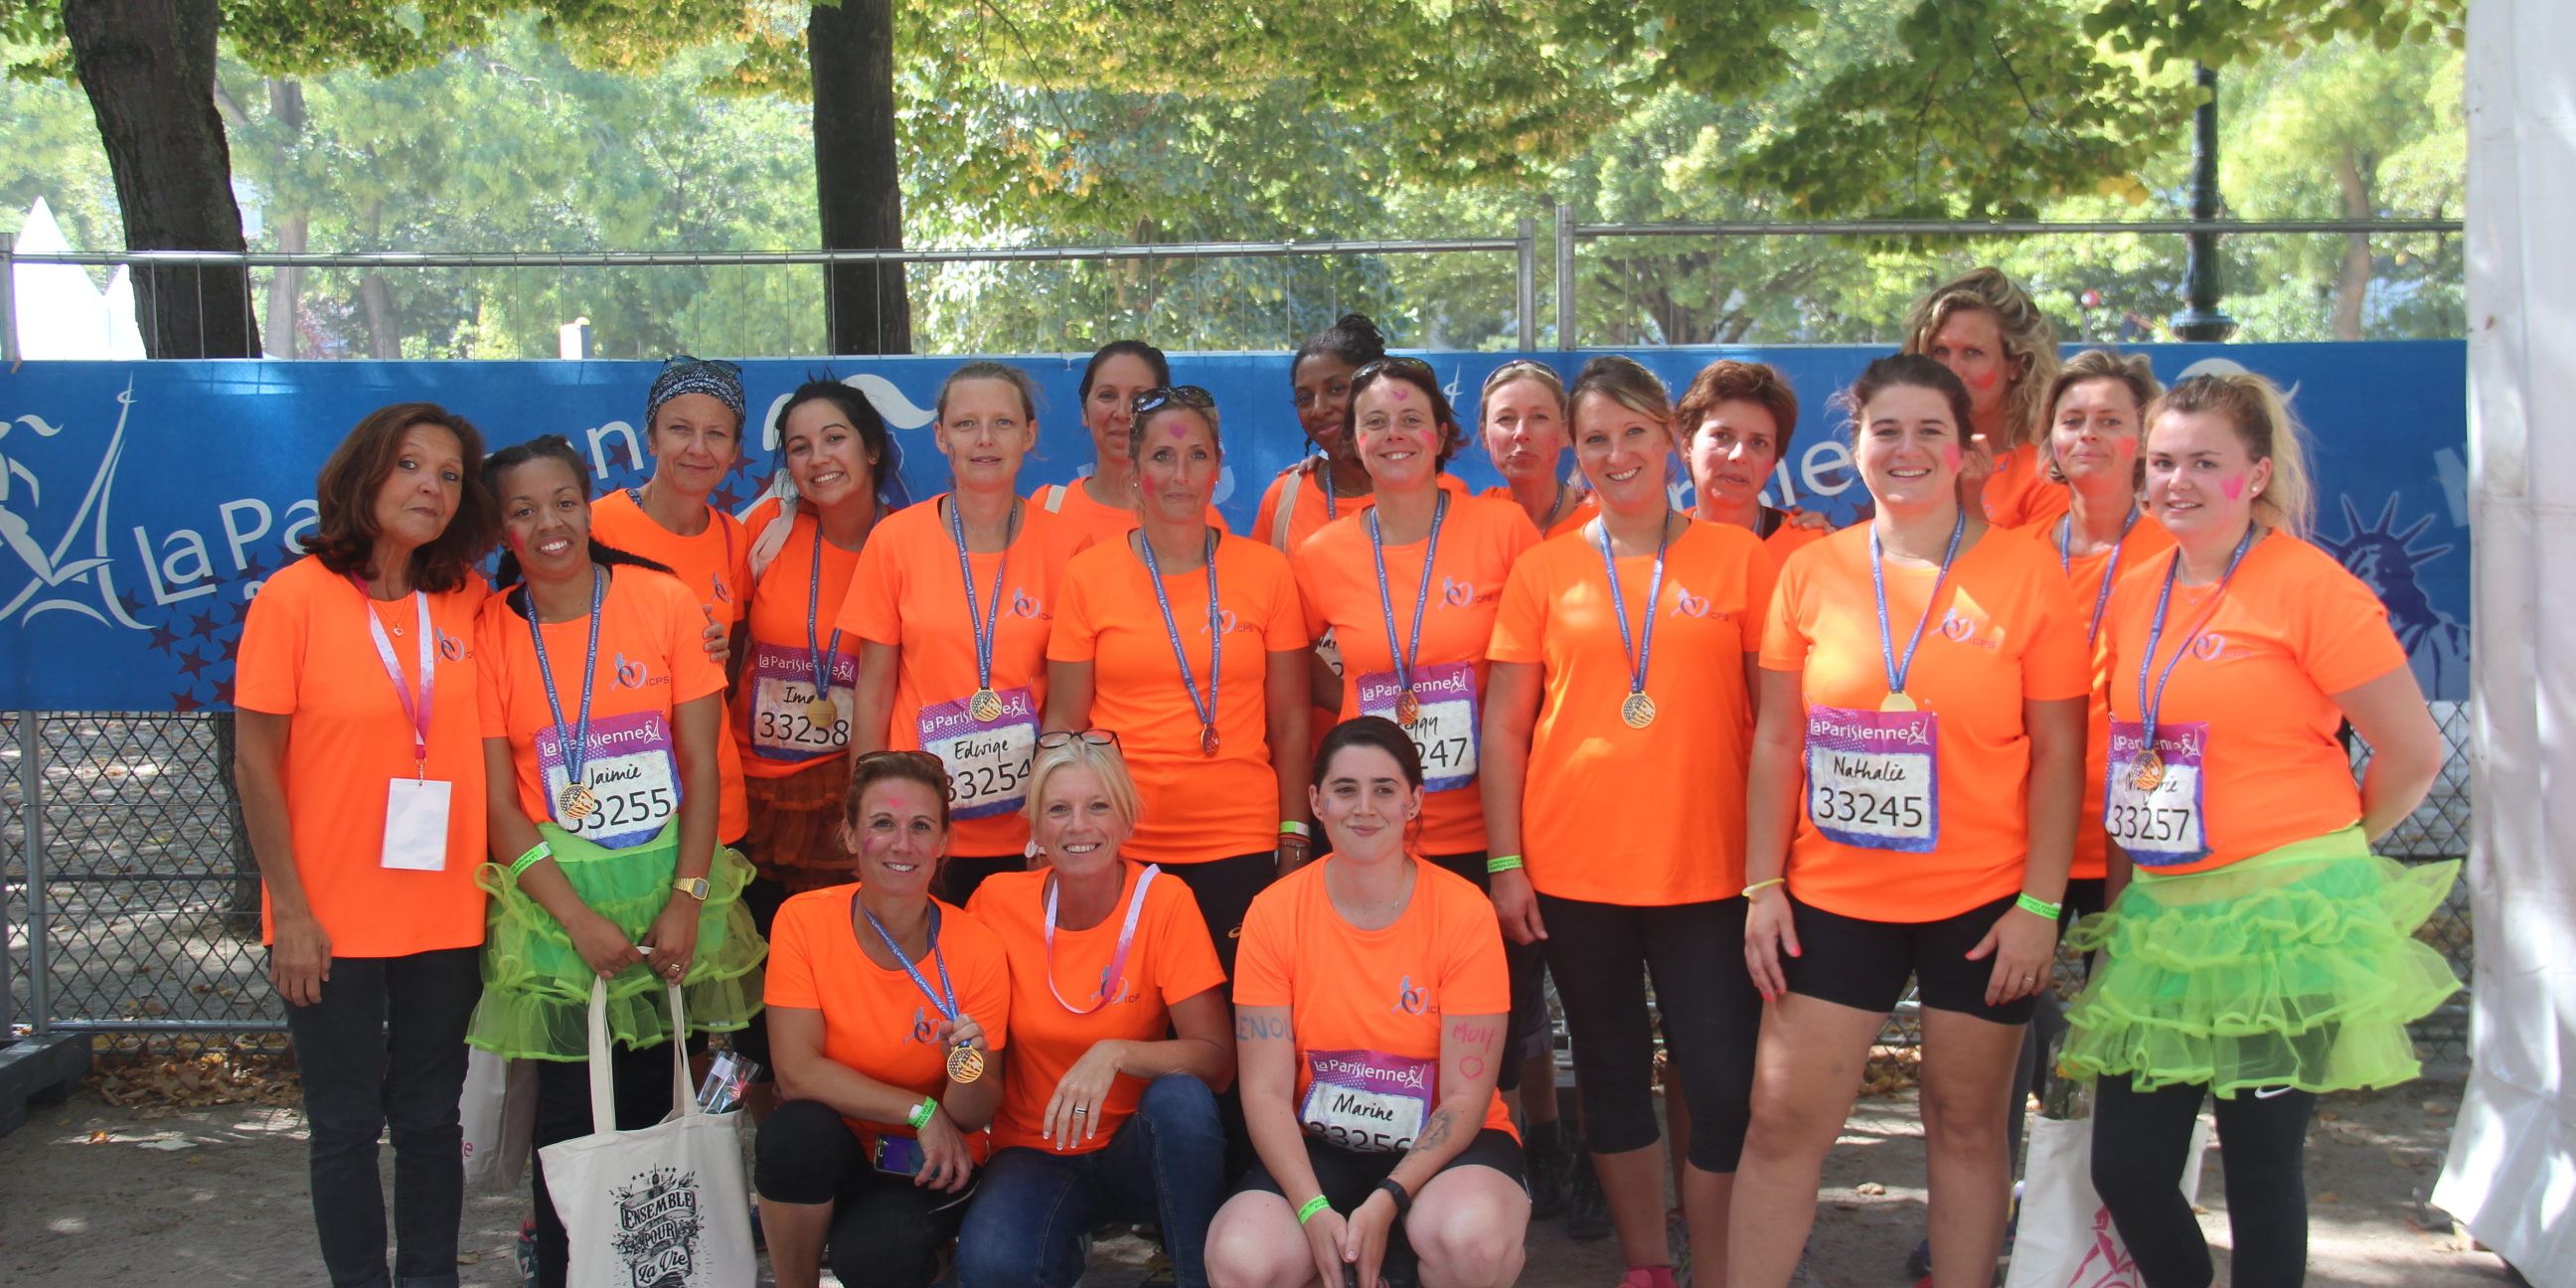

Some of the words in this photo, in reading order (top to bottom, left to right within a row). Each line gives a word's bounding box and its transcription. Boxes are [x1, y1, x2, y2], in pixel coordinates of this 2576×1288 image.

[646, 676, 670, 687] ICPS
[759, 712, 850, 746] 33258
[954, 737, 1010, 762] Edwige
[1417, 737, 1468, 770] 247
[588, 763, 642, 791] Jaimie
[1833, 755, 1907, 782] Nathalie
[1818, 786, 1922, 829] 33245
[2110, 805, 2189, 842] 33257
[1332, 1092, 1394, 1122] Marine
[624, 1192, 693, 1229] ENSEMBLE
[644, 1222, 675, 1247] POUR
[638, 1264, 657, 1284] La
[660, 1249, 689, 1272] Vie
